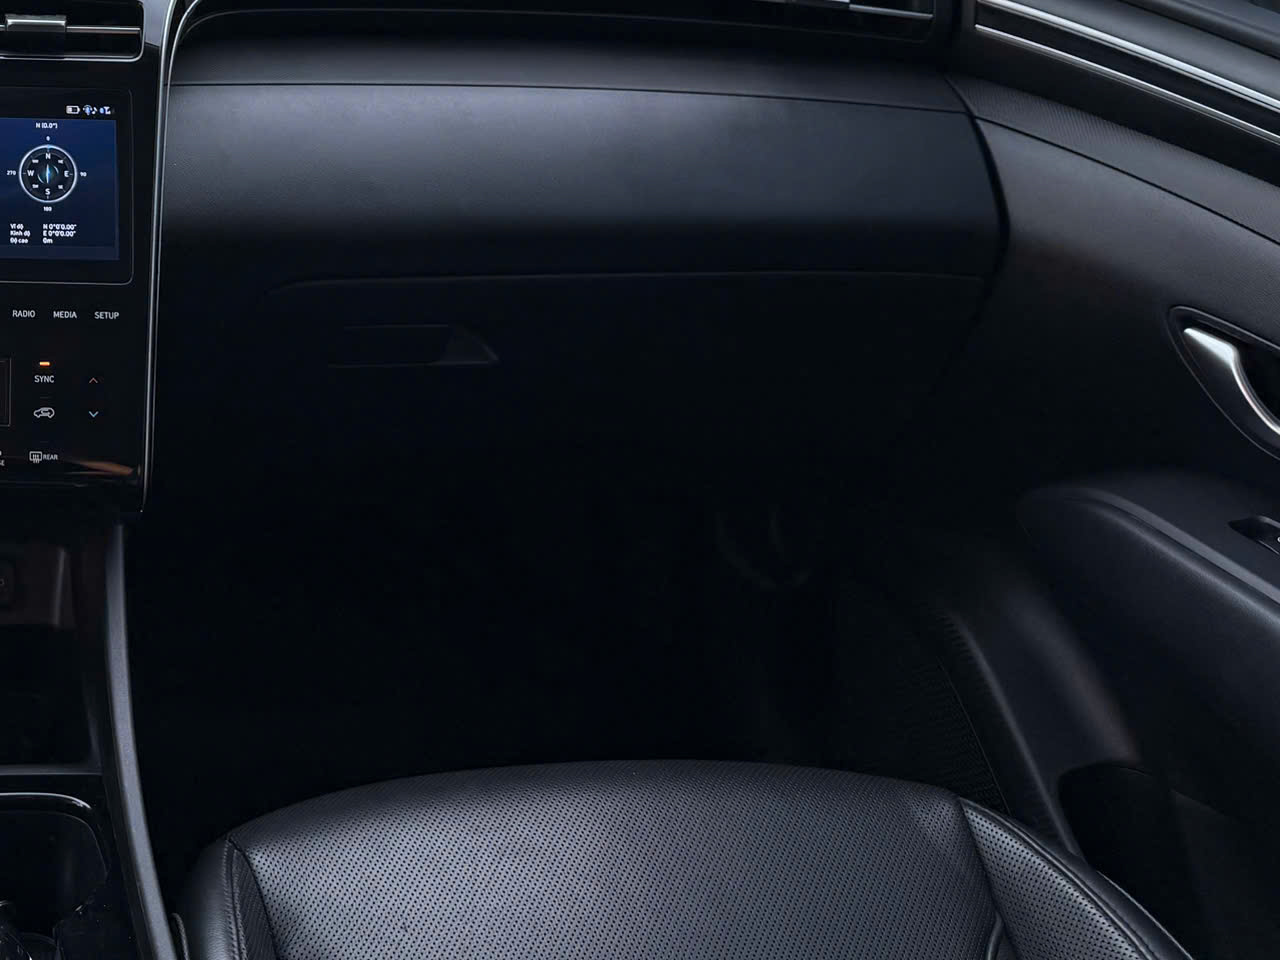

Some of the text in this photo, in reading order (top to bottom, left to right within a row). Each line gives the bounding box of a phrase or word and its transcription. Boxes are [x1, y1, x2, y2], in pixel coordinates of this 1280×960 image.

[12, 309, 36, 318] RADIO
[53, 310, 77, 319] MEDIA
[94, 311, 120, 319] SETUP
[34, 375, 55, 383] SYNC
